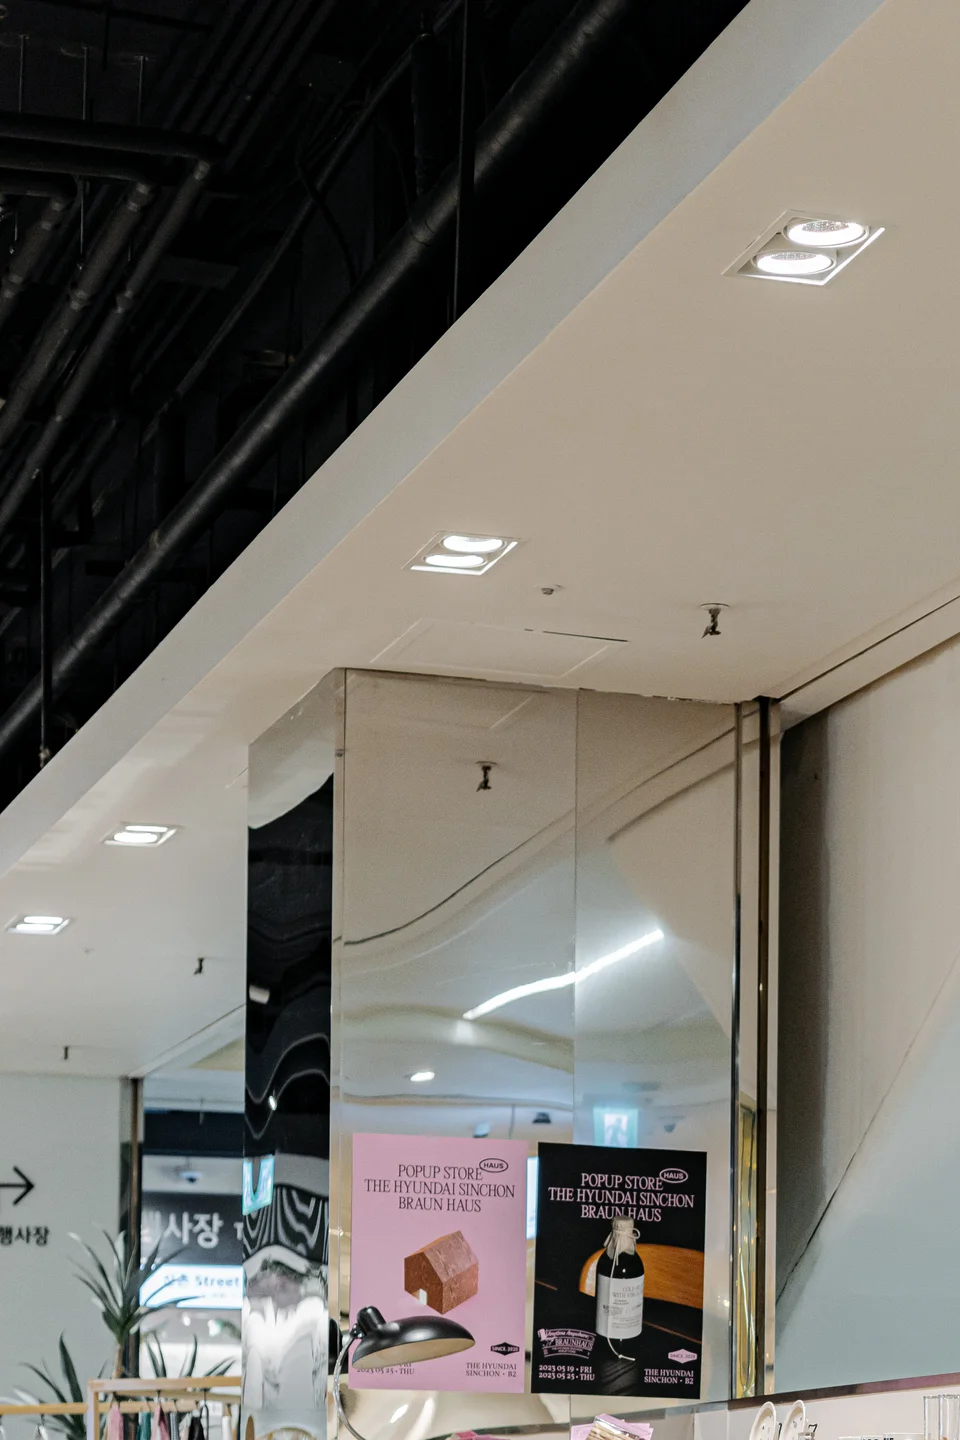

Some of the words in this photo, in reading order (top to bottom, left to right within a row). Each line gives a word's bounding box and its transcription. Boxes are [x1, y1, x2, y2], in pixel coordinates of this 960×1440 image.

[483, 1161, 504, 1170] HAUS
[398, 1164, 441, 1180] POPUP
[443, 1165, 483, 1181] STORE
[663, 1171, 684, 1180] HAUS
[580, 1173, 623, 1188] POPUP
[624, 1175, 664, 1191] STORE
[364, 1178, 391, 1193] THE
[393, 1180, 456, 1196] HYUNDAI
[458, 1183, 516, 1198] SINCHON
[548, 1187, 574, 1202] THE
[576, 1188, 637, 1206] HYUNDAI
[639, 1192, 695, 1208] SINCHON
[398, 1196, 443, 1211] BRAUN
[446, 1198, 482, 1213] HAUS
[580, 1204, 625, 1220] BRAUN
[628, 1207, 662, 1223] HAUS
[466, 1362, 481, 1370] THE
[482, 1362, 517, 1371] HYUNDAI
[538, 1364, 556, 1372] 2023
[557, 1365, 566, 1373] 05
[566, 1365, 575, 1373] 19
[580, 1366, 592, 1374] FRI
[465, 1369, 501, 1378] SINCHON
[507, 1370, 517, 1378] B2
[580, 1373, 595, 1381] THU
[644, 1368, 659, 1376] THE
[660, 1369, 694, 1378] HYUNDAI
[644, 1376, 678, 1384] SINCHON
[684, 1377, 694, 1385] B2
